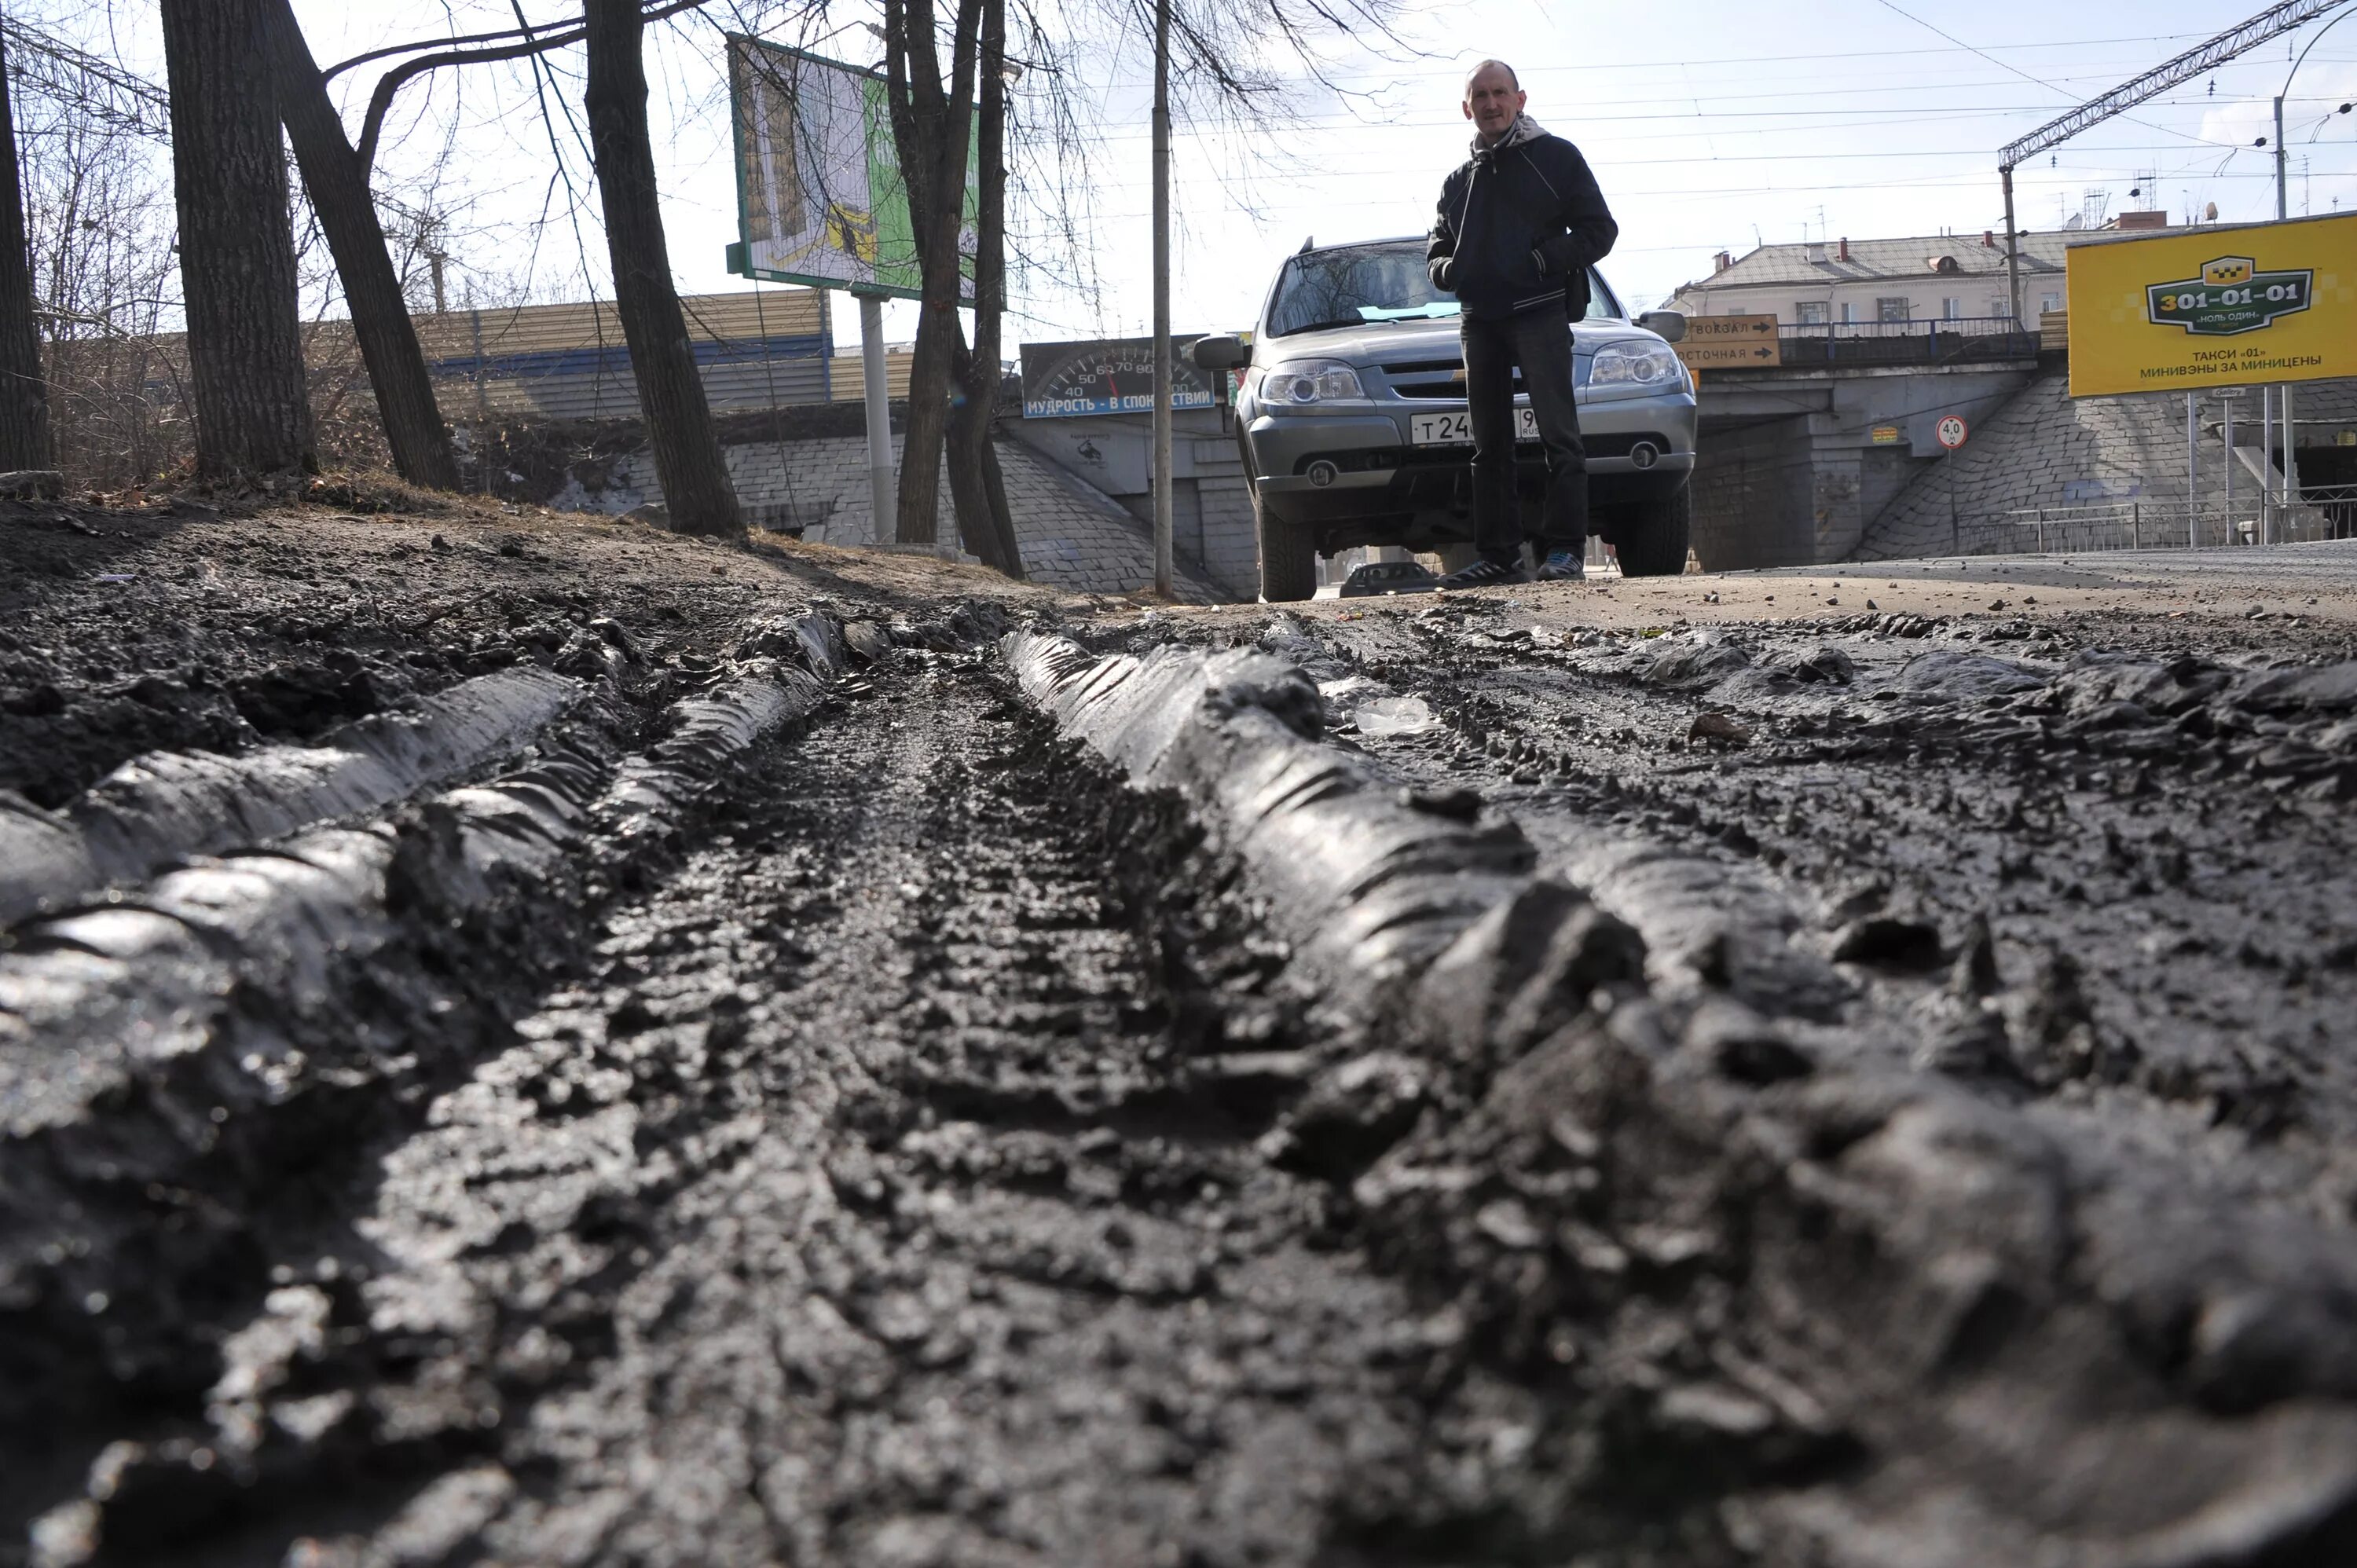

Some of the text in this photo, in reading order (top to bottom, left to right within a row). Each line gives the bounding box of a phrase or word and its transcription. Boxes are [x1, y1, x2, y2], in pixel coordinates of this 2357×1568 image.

[2161, 284, 2297, 311] 301-01-01
[1696, 323, 1748, 335] ВОКЗАЛ
[1677, 350, 1746, 361] ОСТОЧНАЯ
[2193, 348, 2266, 361] ТАКСИ «01»
[1116, 362, 1132, 371] 70
[1136, 365, 1154, 374] 80
[2139, 363, 2217, 379] МИНИВЭНЫ
[2241, 355, 2322, 370] МИНИЦЕНЫ
[1079, 374, 1096, 383] 50
[1065, 387, 1083, 397] 40
[1028, 398, 1094, 415] МУДРОСТЬ
[1109, 397, 1118, 409] В
